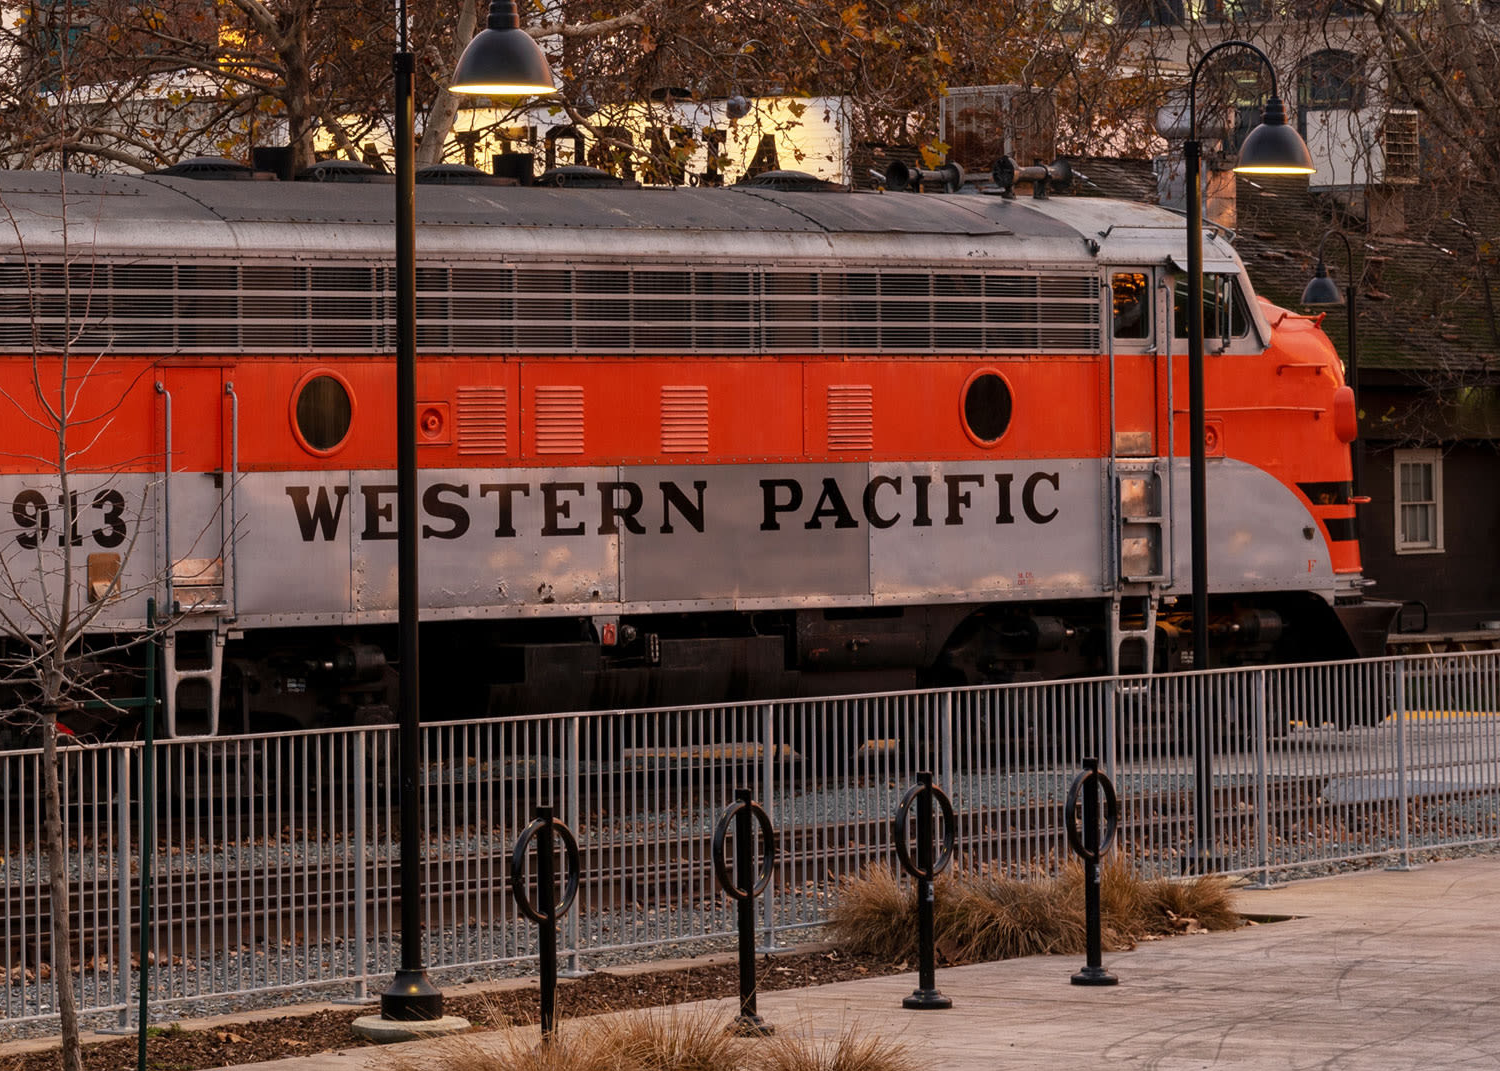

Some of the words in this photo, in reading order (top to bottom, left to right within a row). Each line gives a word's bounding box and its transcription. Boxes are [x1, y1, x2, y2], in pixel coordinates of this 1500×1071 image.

[12, 489, 127, 550] 913
[285, 480, 707, 542] WESTERN
[759, 472, 1059, 531] PACIFIC
